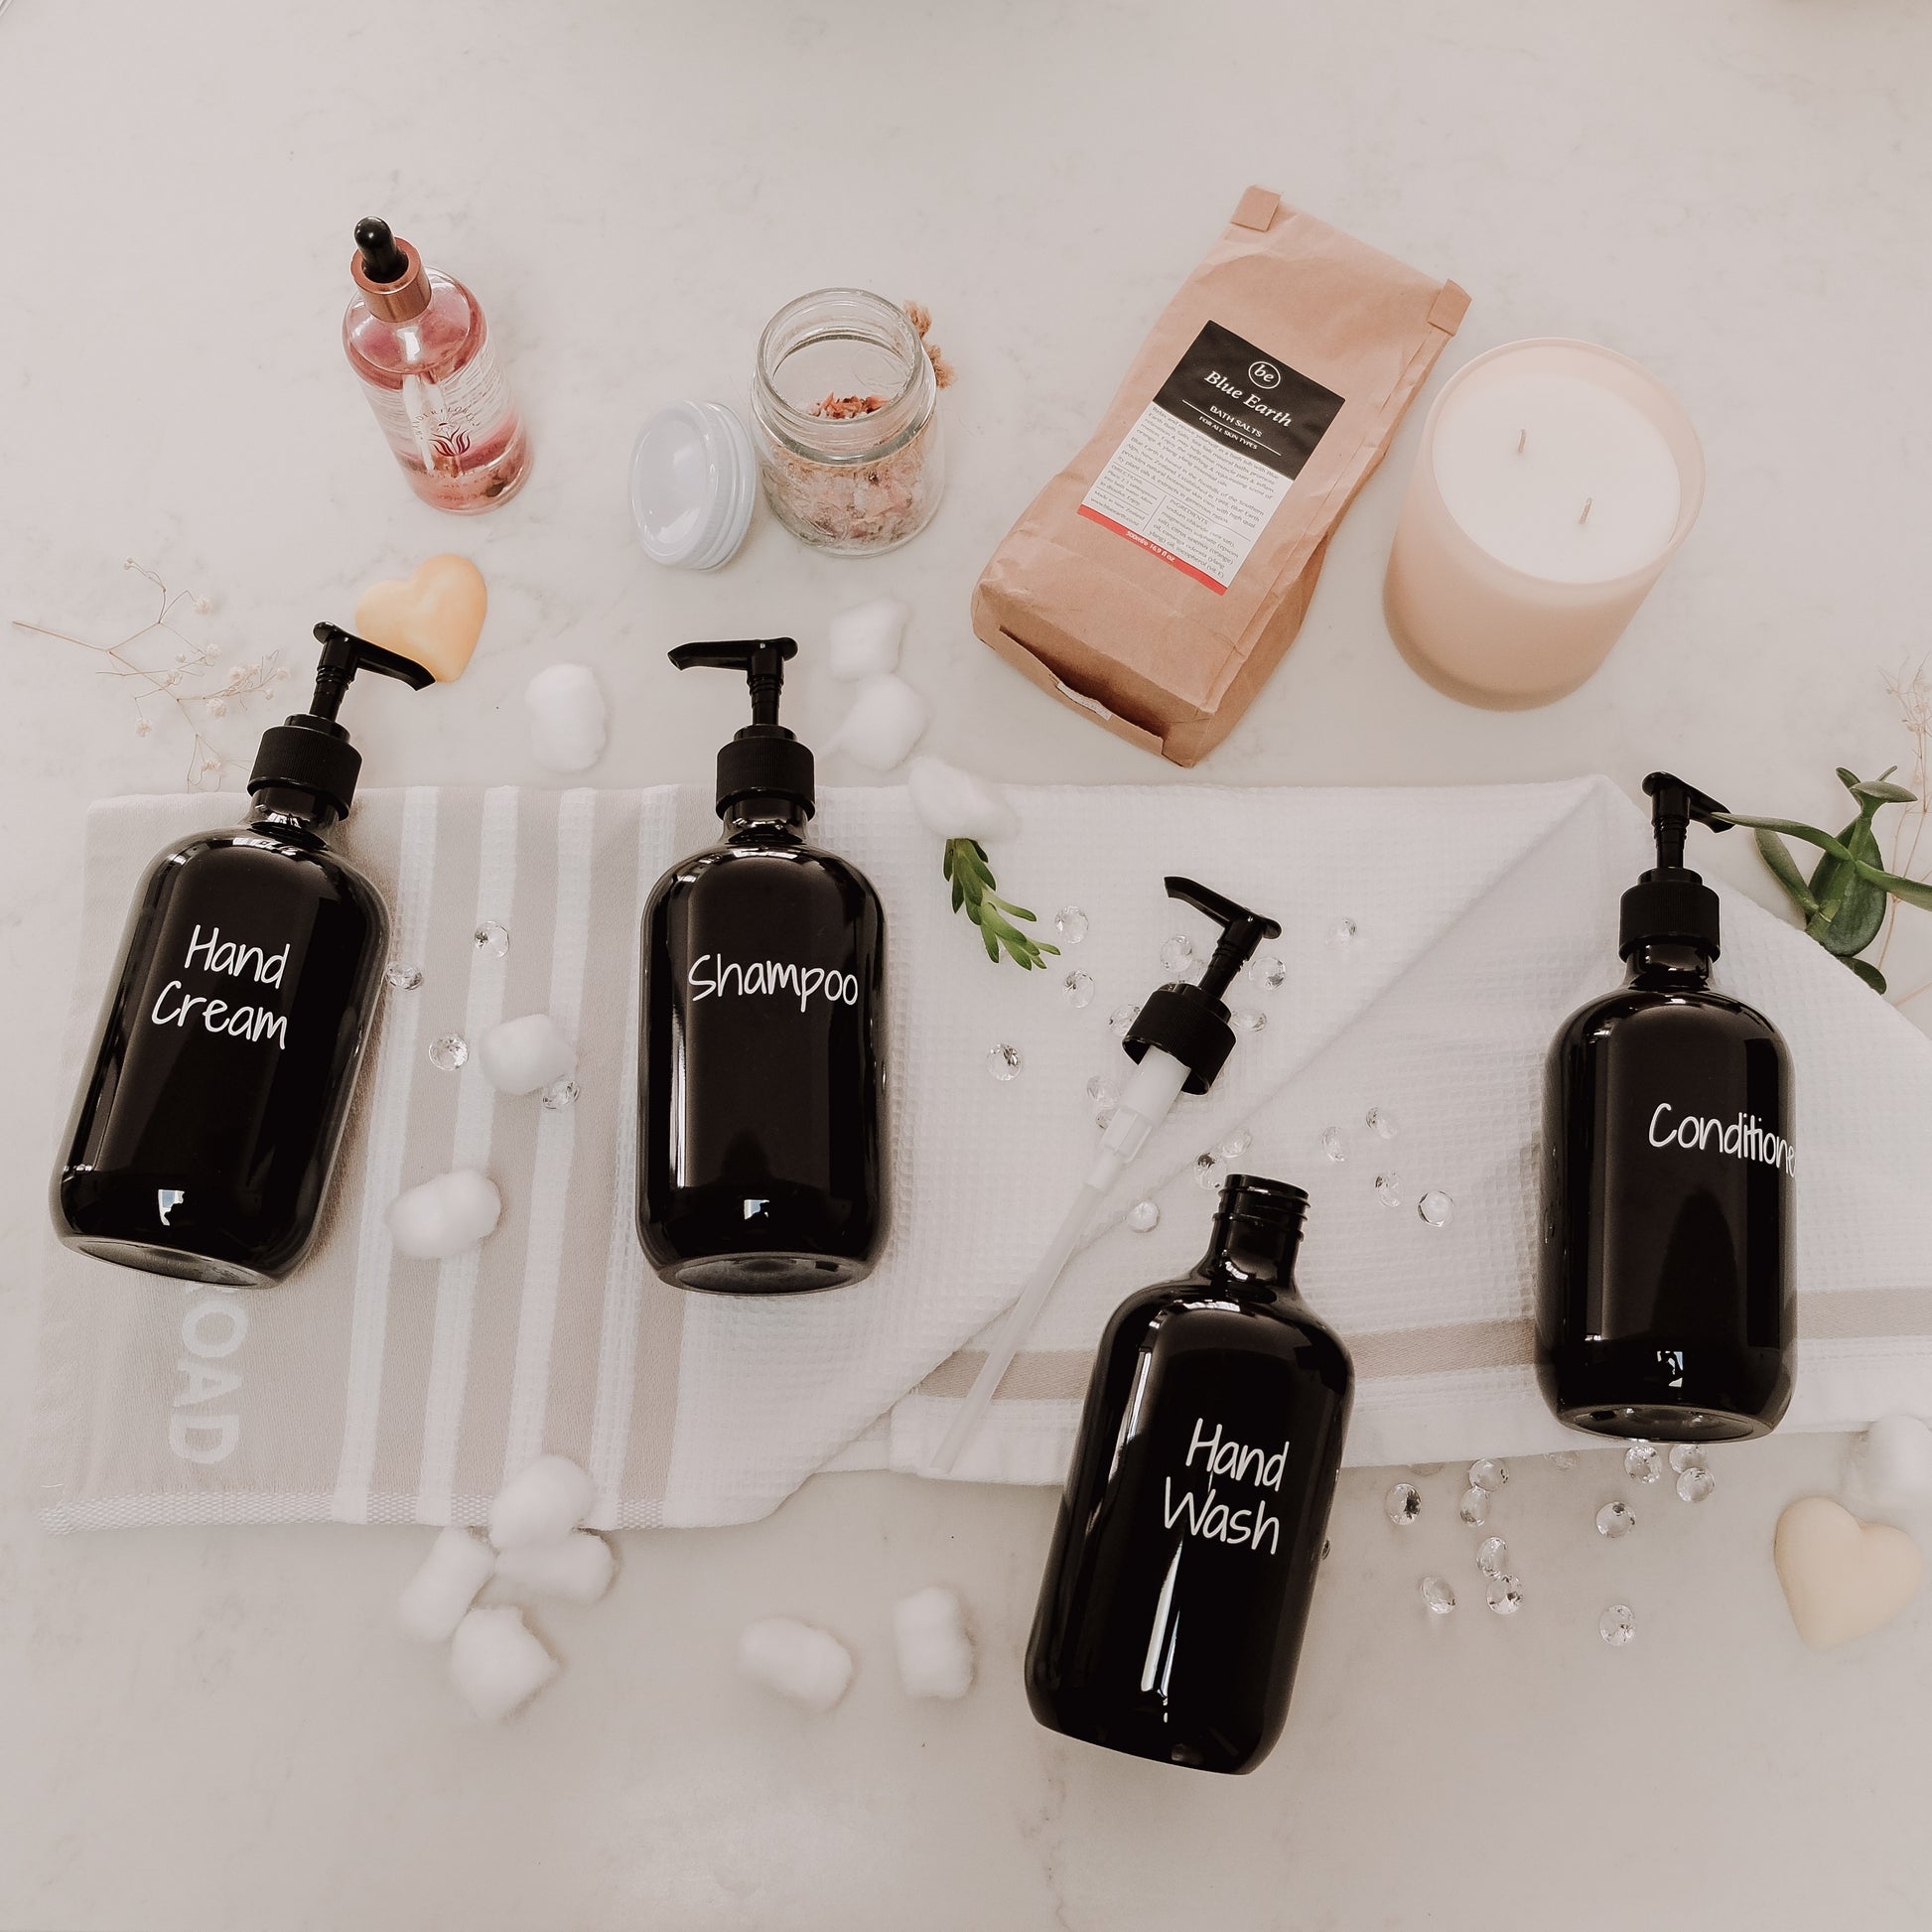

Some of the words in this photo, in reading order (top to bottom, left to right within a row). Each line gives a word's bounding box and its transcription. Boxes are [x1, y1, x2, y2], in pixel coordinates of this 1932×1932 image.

[1204, 370, 1243, 399] Blue
[1243, 394, 1292, 427] Earth
[1254, 364, 1275, 382] be
[1199, 416, 1212, 426] FOR
[1224, 430, 1238, 440] SKIN
[1239, 438, 1258, 449] TYPES
[1210, 405, 1235, 423] BATH
[1235, 420, 1262, 437] SALTS
[1150, 543, 1162, 553] 16.9
[184, 924, 291, 990] Hand
[687, 952, 859, 1014] Shampoo
[151, 980, 288, 1050] Cream
[1648, 1102, 1797, 1177] Conditione
[170, 1283, 249, 1464] OAD
[1185, 1418, 1291, 1492] Hand
[1164, 1475, 1281, 1556] Wash
